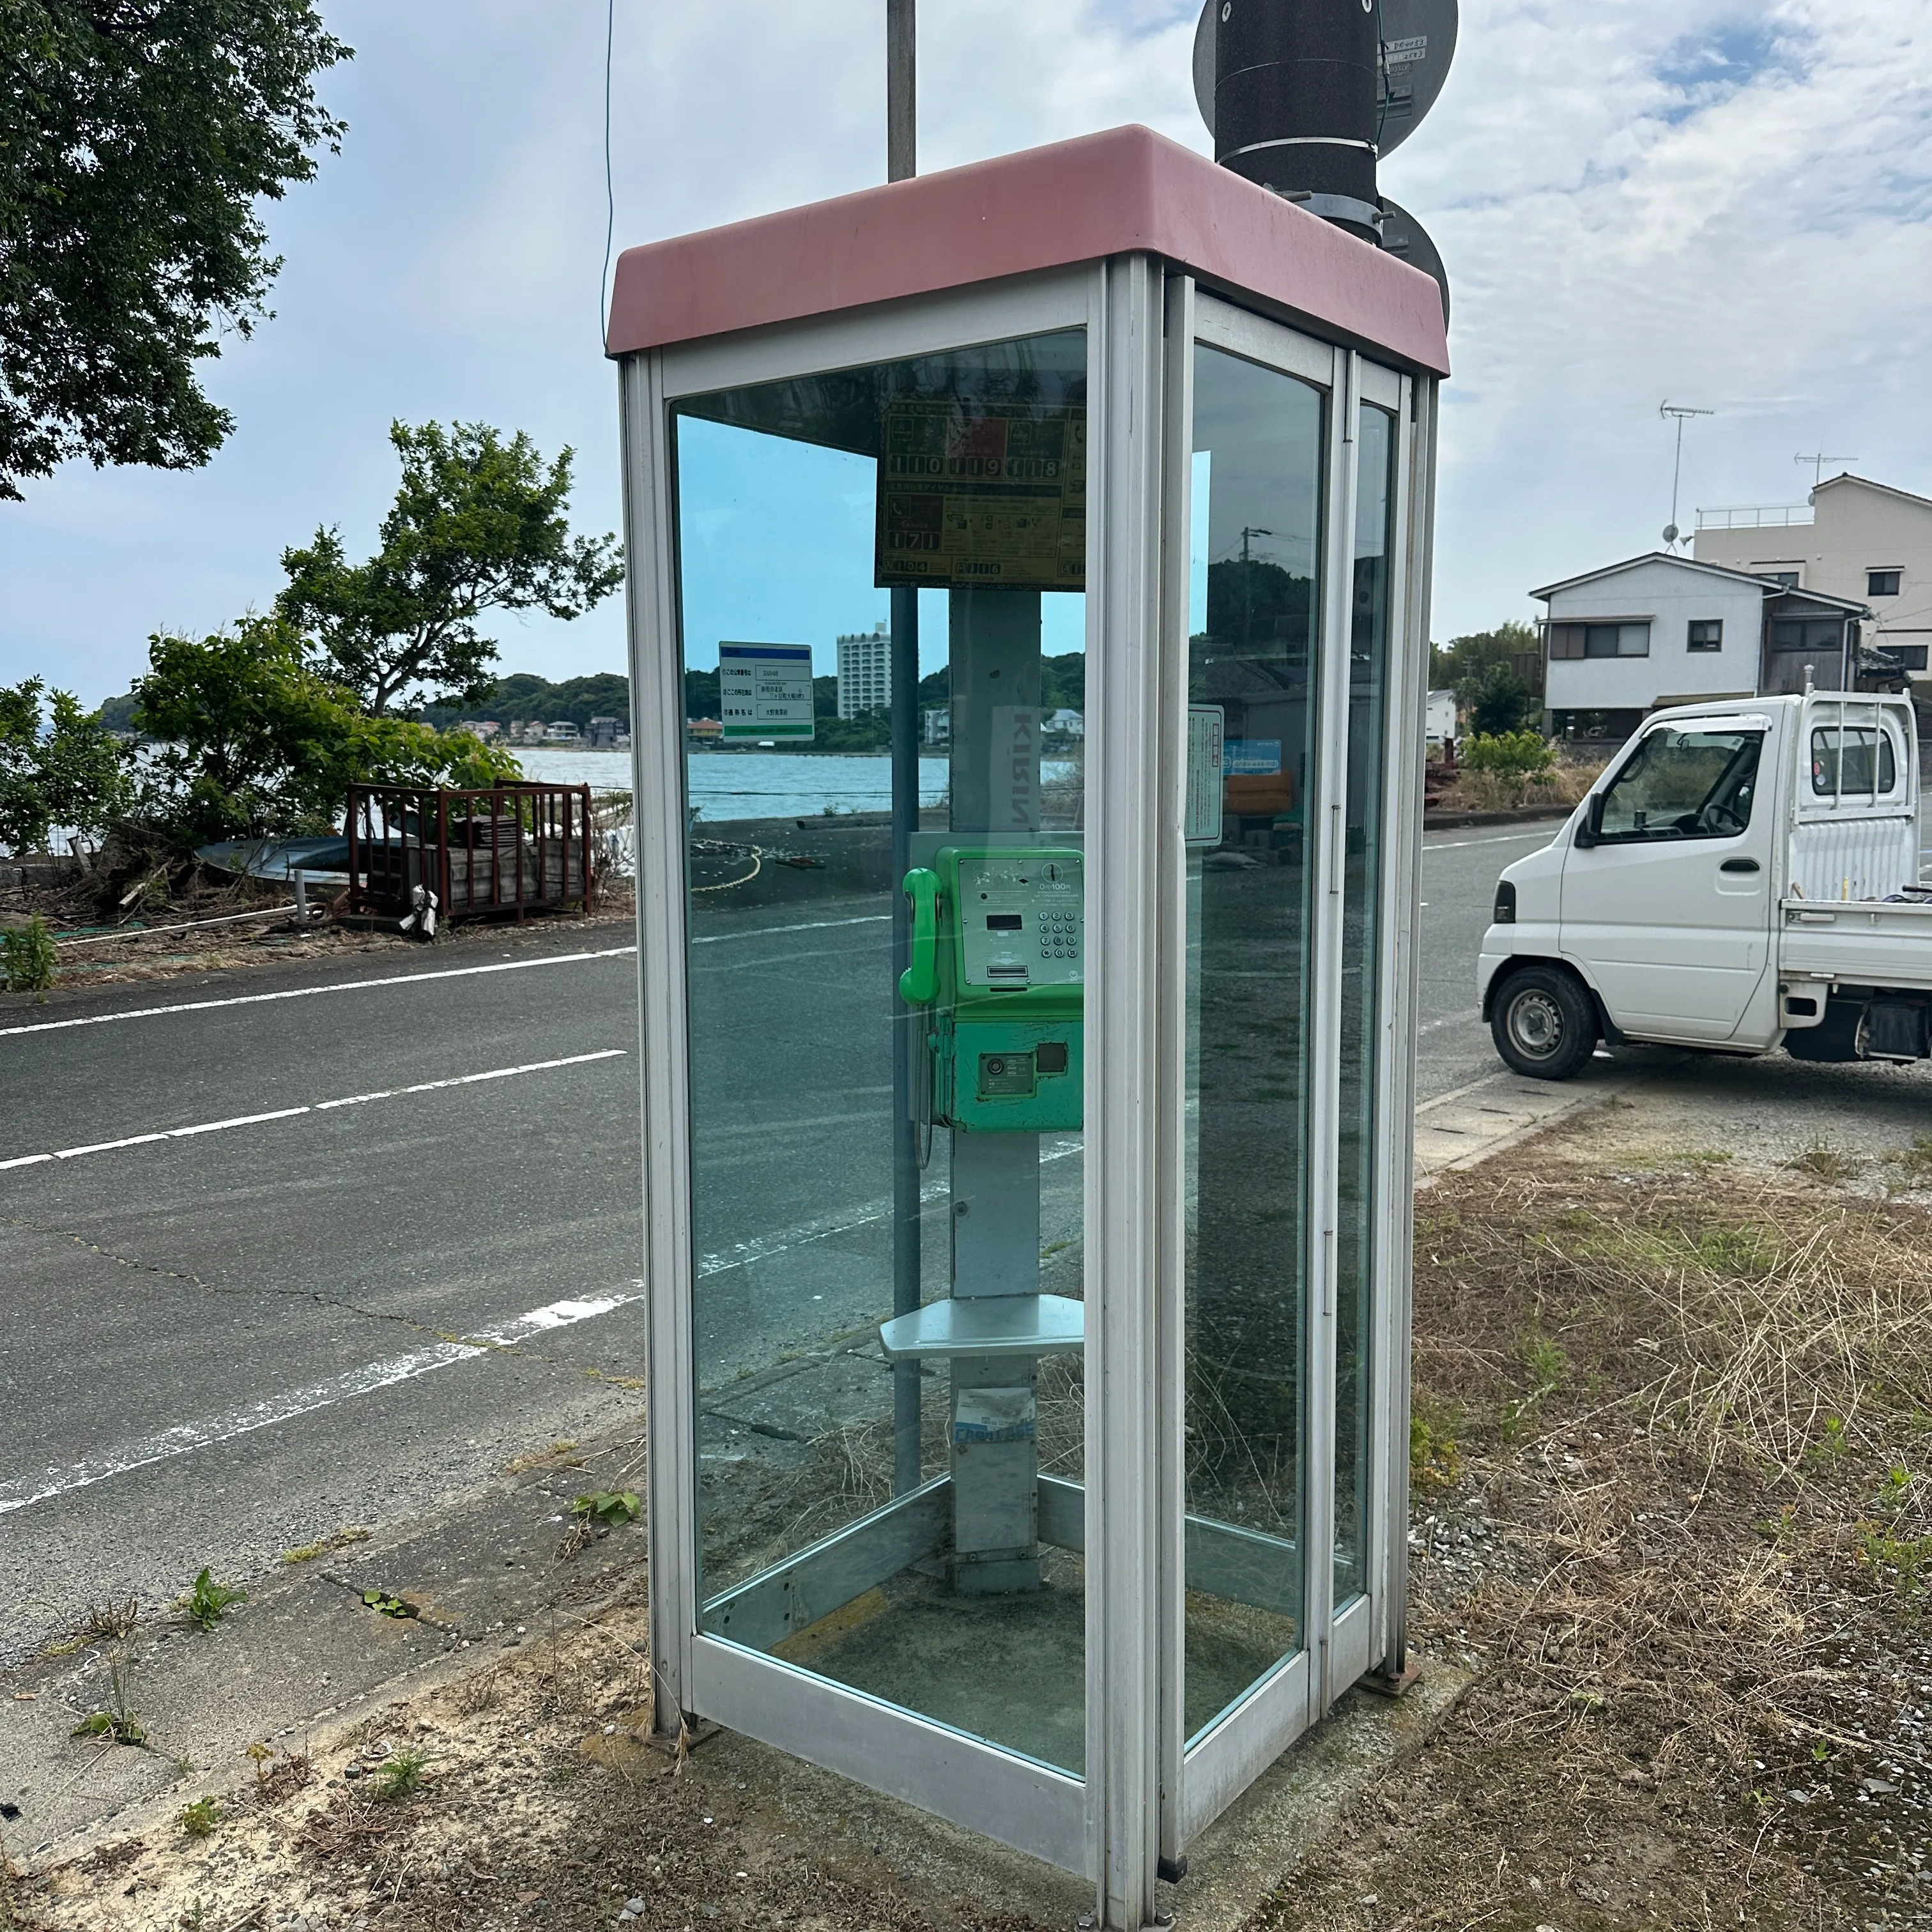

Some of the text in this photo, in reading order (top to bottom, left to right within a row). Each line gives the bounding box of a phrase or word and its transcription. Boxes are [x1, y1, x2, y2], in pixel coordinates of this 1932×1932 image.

[896, 456, 940, 473] 110
[954, 458, 999, 476] 119
[1012, 460, 1056, 477] 118
[894, 533, 933, 549] 171
